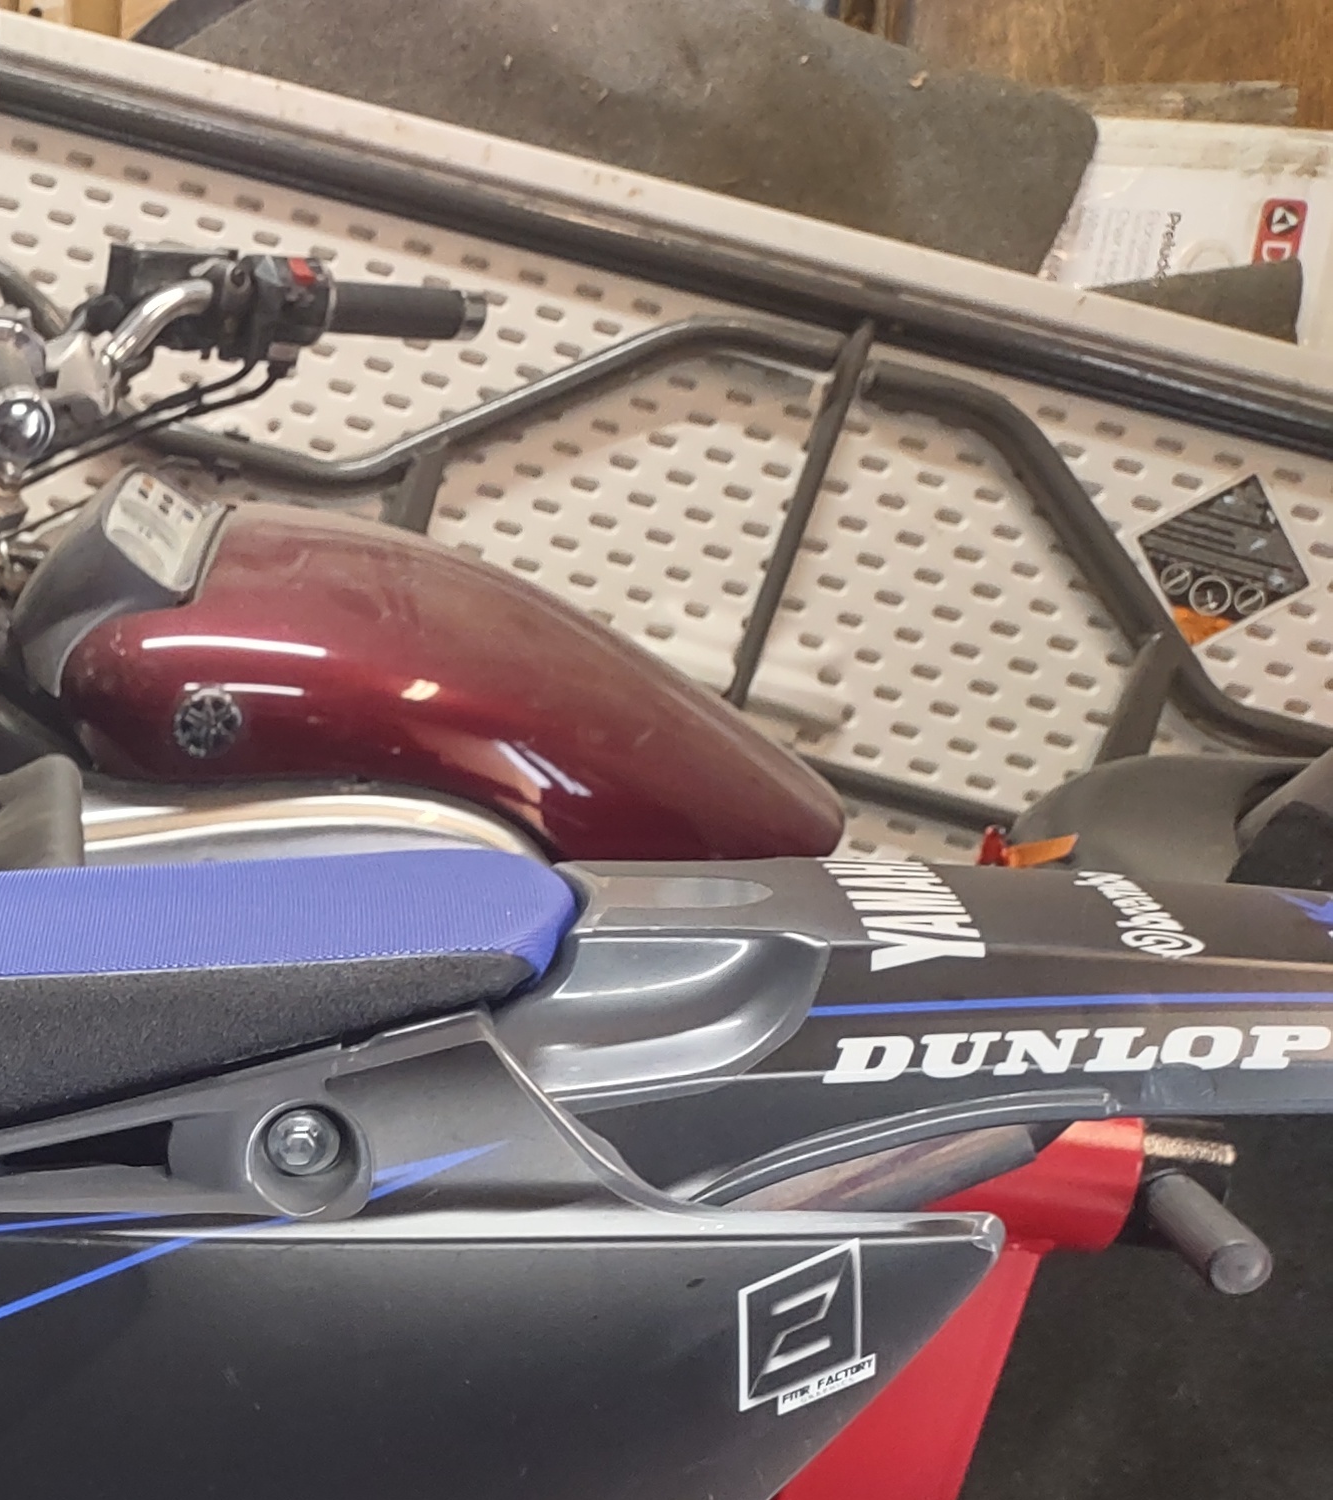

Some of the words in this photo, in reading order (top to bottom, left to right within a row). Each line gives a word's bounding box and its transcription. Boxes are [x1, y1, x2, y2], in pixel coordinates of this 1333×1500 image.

[818, 858, 986, 971] YAMAH
[822, 1026, 1332, 1084] DUNLOP
[817, 1358, 874, 1390] FACTORY
